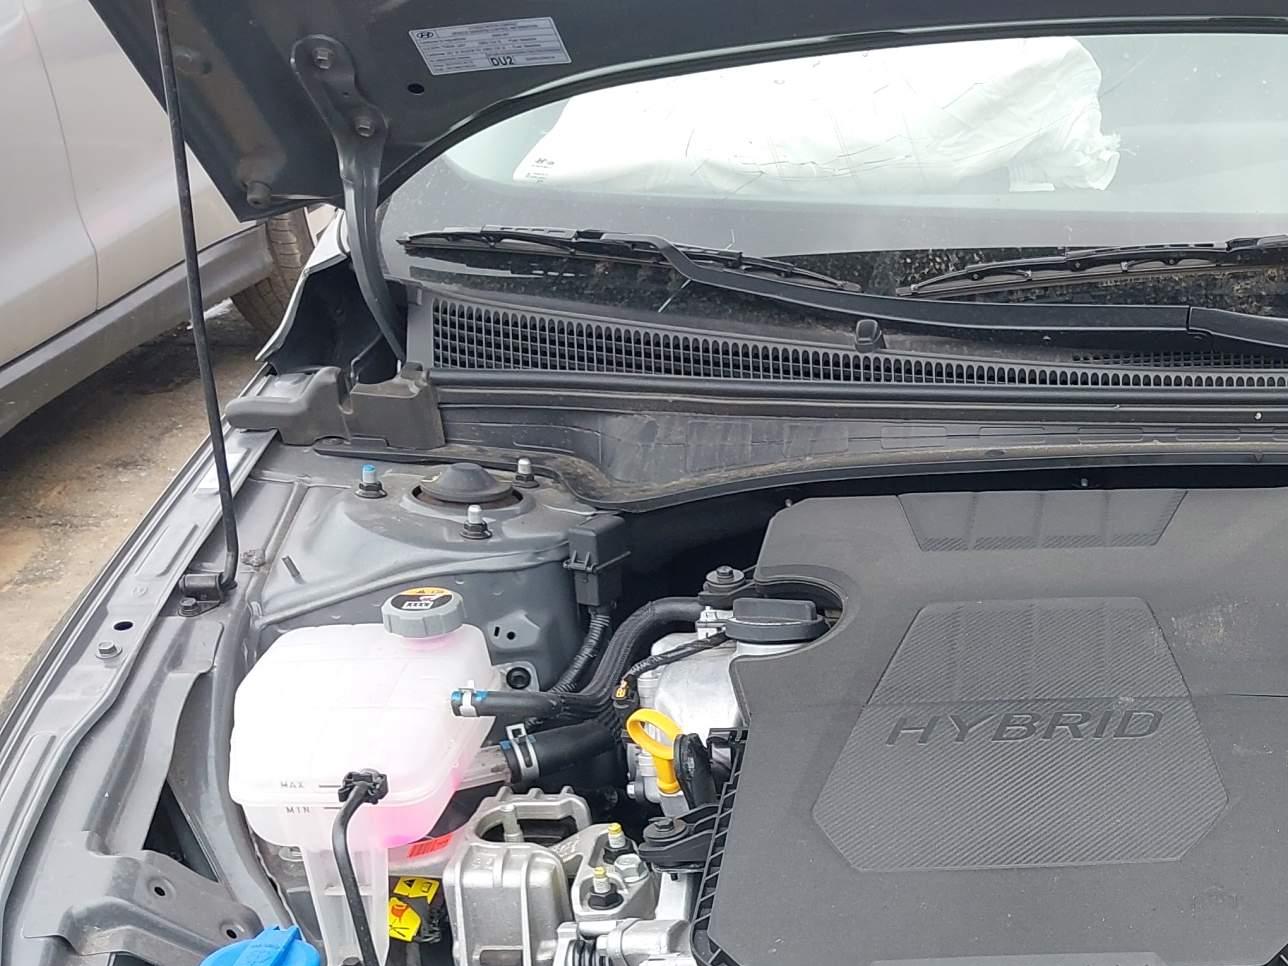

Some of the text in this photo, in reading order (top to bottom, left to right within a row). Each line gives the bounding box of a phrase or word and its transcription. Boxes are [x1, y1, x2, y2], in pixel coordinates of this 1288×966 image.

[490, 56, 515, 67] DU2
[886, 710, 1164, 746] HYBRID
[280, 780, 304, 789] MAX
[285, 806, 310, 814] MIN
